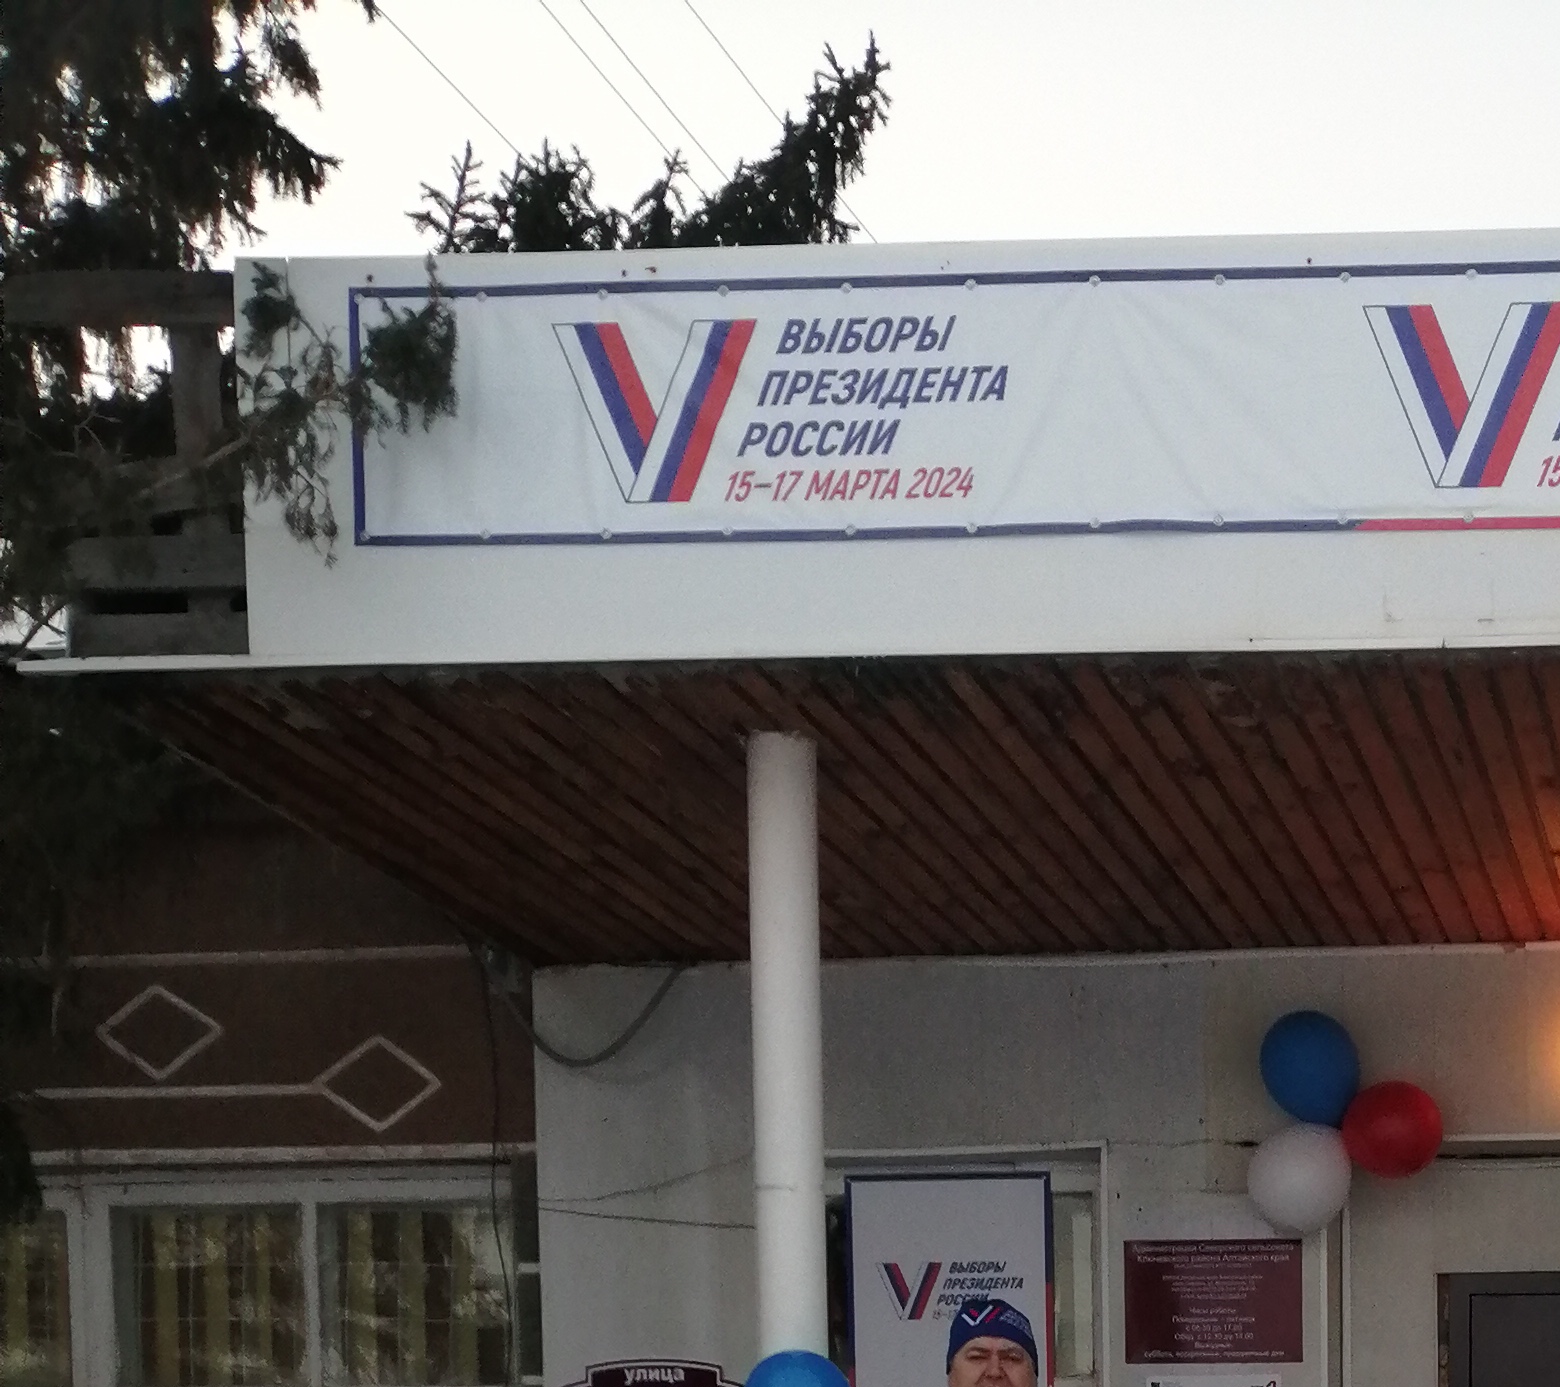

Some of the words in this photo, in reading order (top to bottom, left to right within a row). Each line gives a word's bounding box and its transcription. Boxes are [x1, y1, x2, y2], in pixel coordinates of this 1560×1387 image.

[776, 315, 956, 354] ВЫБОРЫ
[758, 365, 1008, 410] ПРЕЗИДЕНТА
[738, 419, 901, 457] РОССИИ
[805, 468, 901, 500] МАРТА
[905, 466, 974, 499] 2024
[943, 1277, 1023, 1290] ПРЕЗИДЕНТА
[949, 1261, 1006, 1273] ВЫБОРЫ
[624, 1367, 685, 1385] улица
